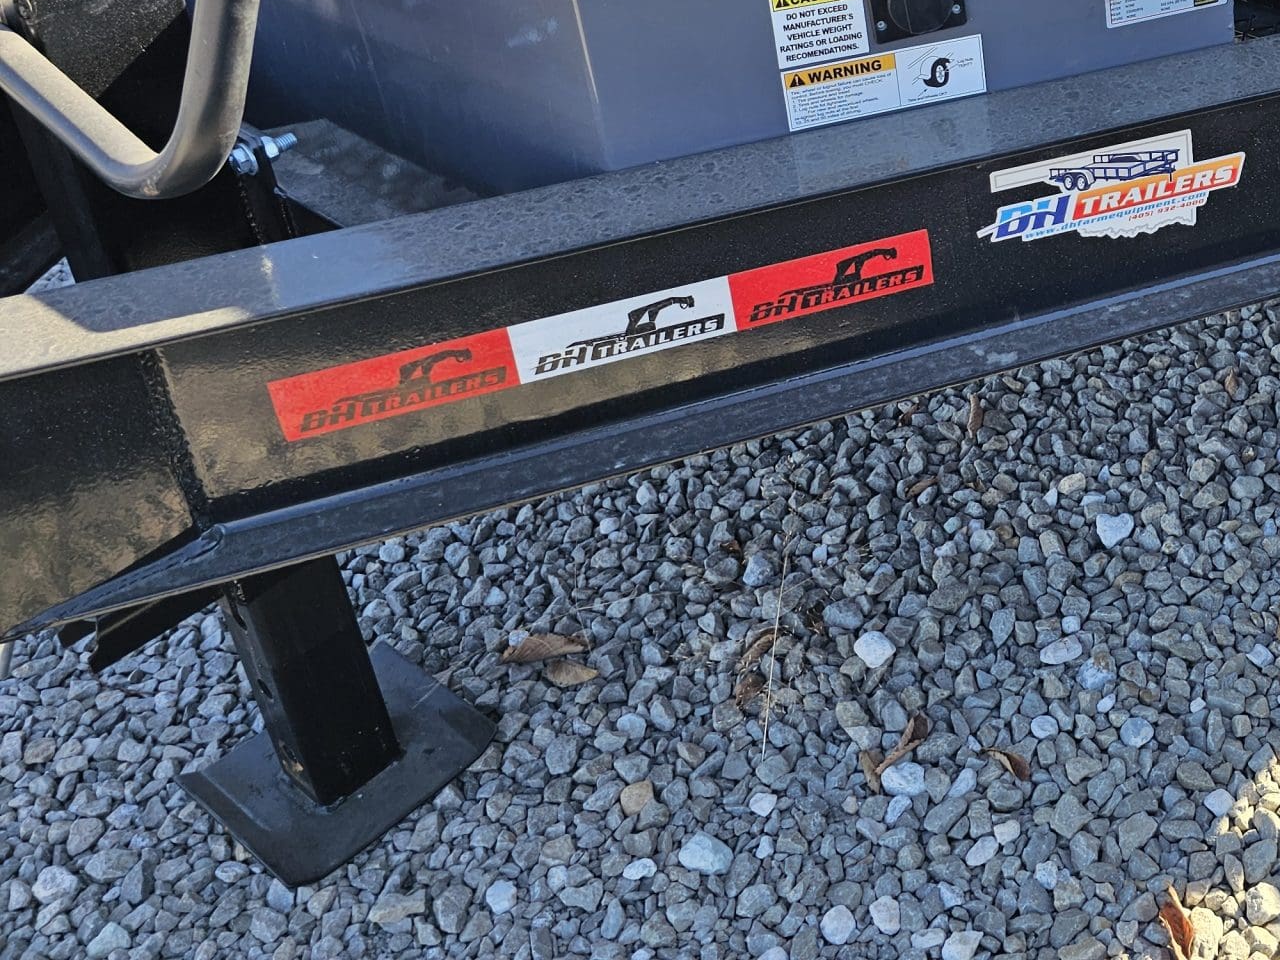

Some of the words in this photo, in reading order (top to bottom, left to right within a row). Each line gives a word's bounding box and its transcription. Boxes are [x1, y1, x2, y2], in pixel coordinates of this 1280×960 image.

[786, 13, 798, 21] DO
[799, 9, 816, 18] NOT
[817, 4, 848, 15] EXCEED
[780, 41, 814, 53] RATINGS
[815, 38, 827, 47] OR
[828, 32, 863, 44] LOADING
[787, 29, 821, 42] VEHICLE
[822, 23, 853, 35] WEIGHT
[786, 42, 859, 63] RECOMENDATIONS.
[808, 60, 882, 83] WARNING
[996, 195, 1071, 238] DH
[1081, 165, 1234, 214] TRAILERS
[1025, 191, 1207, 239] www.dhfarmequipment.com
[1129, 210, 1153, 221] (405)
[750, 294, 796, 321] DH
[806, 270, 919, 307] TRAILERS
[535, 344, 586, 375] DH
[596, 318, 719, 358] TRAILERS
[301, 400, 356, 432] DH
[366, 369, 502, 414] TRAILERS
